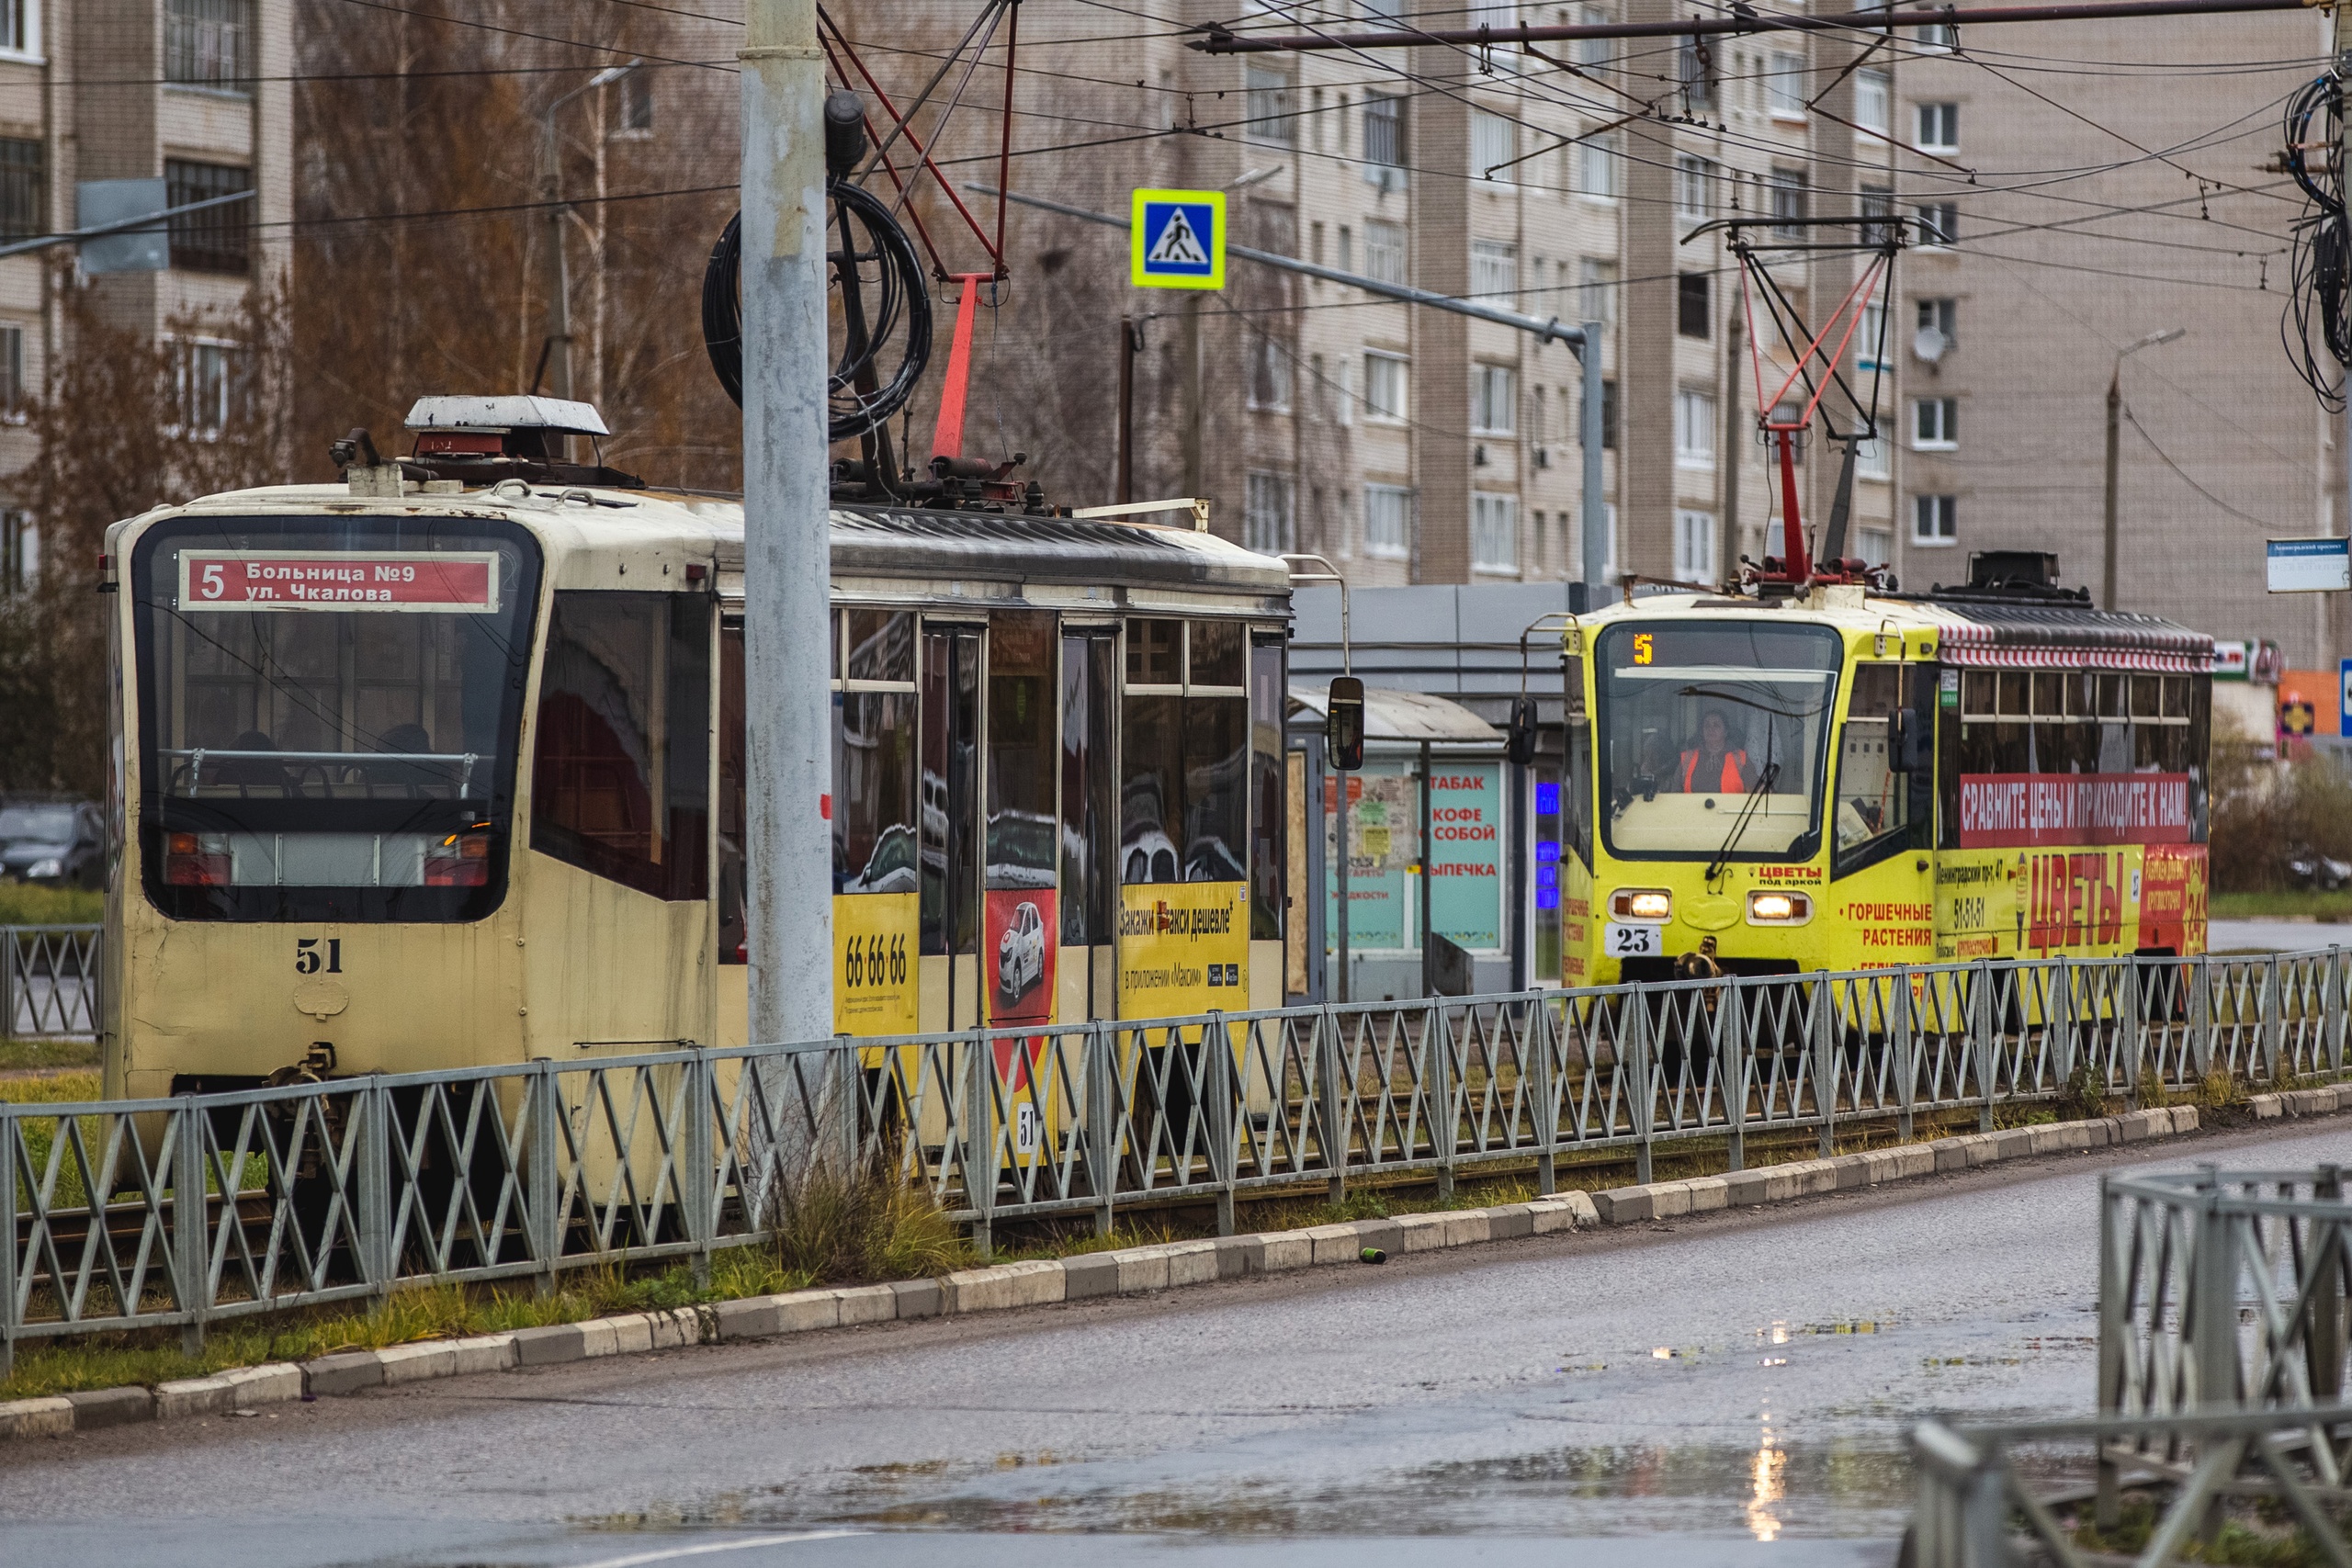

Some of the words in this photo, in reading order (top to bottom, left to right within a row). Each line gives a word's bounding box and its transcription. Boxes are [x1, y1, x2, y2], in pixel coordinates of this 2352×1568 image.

[201, 565, 225, 600] 5
[246, 563, 365, 584] Больница
[374, 565, 416, 583] №9
[245, 585, 281, 602] ул.
[289, 584, 392, 603] Чкалова
[1634, 633, 1654, 665] 5
[1430, 776, 1485, 790] ТАБАК
[1433, 808, 1482, 822] КОФЕ
[1962, 782, 2026, 832] СРАВНИТЕ
[2029, 782, 2064, 838] ЦЕНЫ
[2066, 782, 2075, 828] И
[2077, 781, 2145, 837] ПРИХОДИТЕ
[2148, 781, 2157, 826] К
[2159, 780, 2188, 826] НАМ!
[1434, 826, 1497, 840] СОБОЙ
[1419, 863, 1497, 877] ЫПЕЧКА
[1758, 866, 1823, 880] ЦВЕТЫ
[1936, 861, 1982, 889] Ленинградский
[1995, 858, 2004, 882] 47
[1758, 878, 1781, 886] под
[1784, 877, 1823, 886] аркой
[1331, 890, 1389, 900] ЖДКОСТИ
[2029, 852, 2124, 959] ЦВЕТЫ
[1119, 899, 1155, 937] Закажи
[1849, 903, 1933, 921] ГОРШЕЧНЫЕ
[1954, 897, 1985, 930] 51-51-51
[1617, 929, 1650, 953] 23
[1862, 929, 1932, 946] РАСТЕНИЯ
[295, 938, 343, 975] 51
[1130, 969, 1170, 995] приложении
[1171, 962, 1202, 987] «Максим»
[1021, 1111, 1034, 1147] 51
